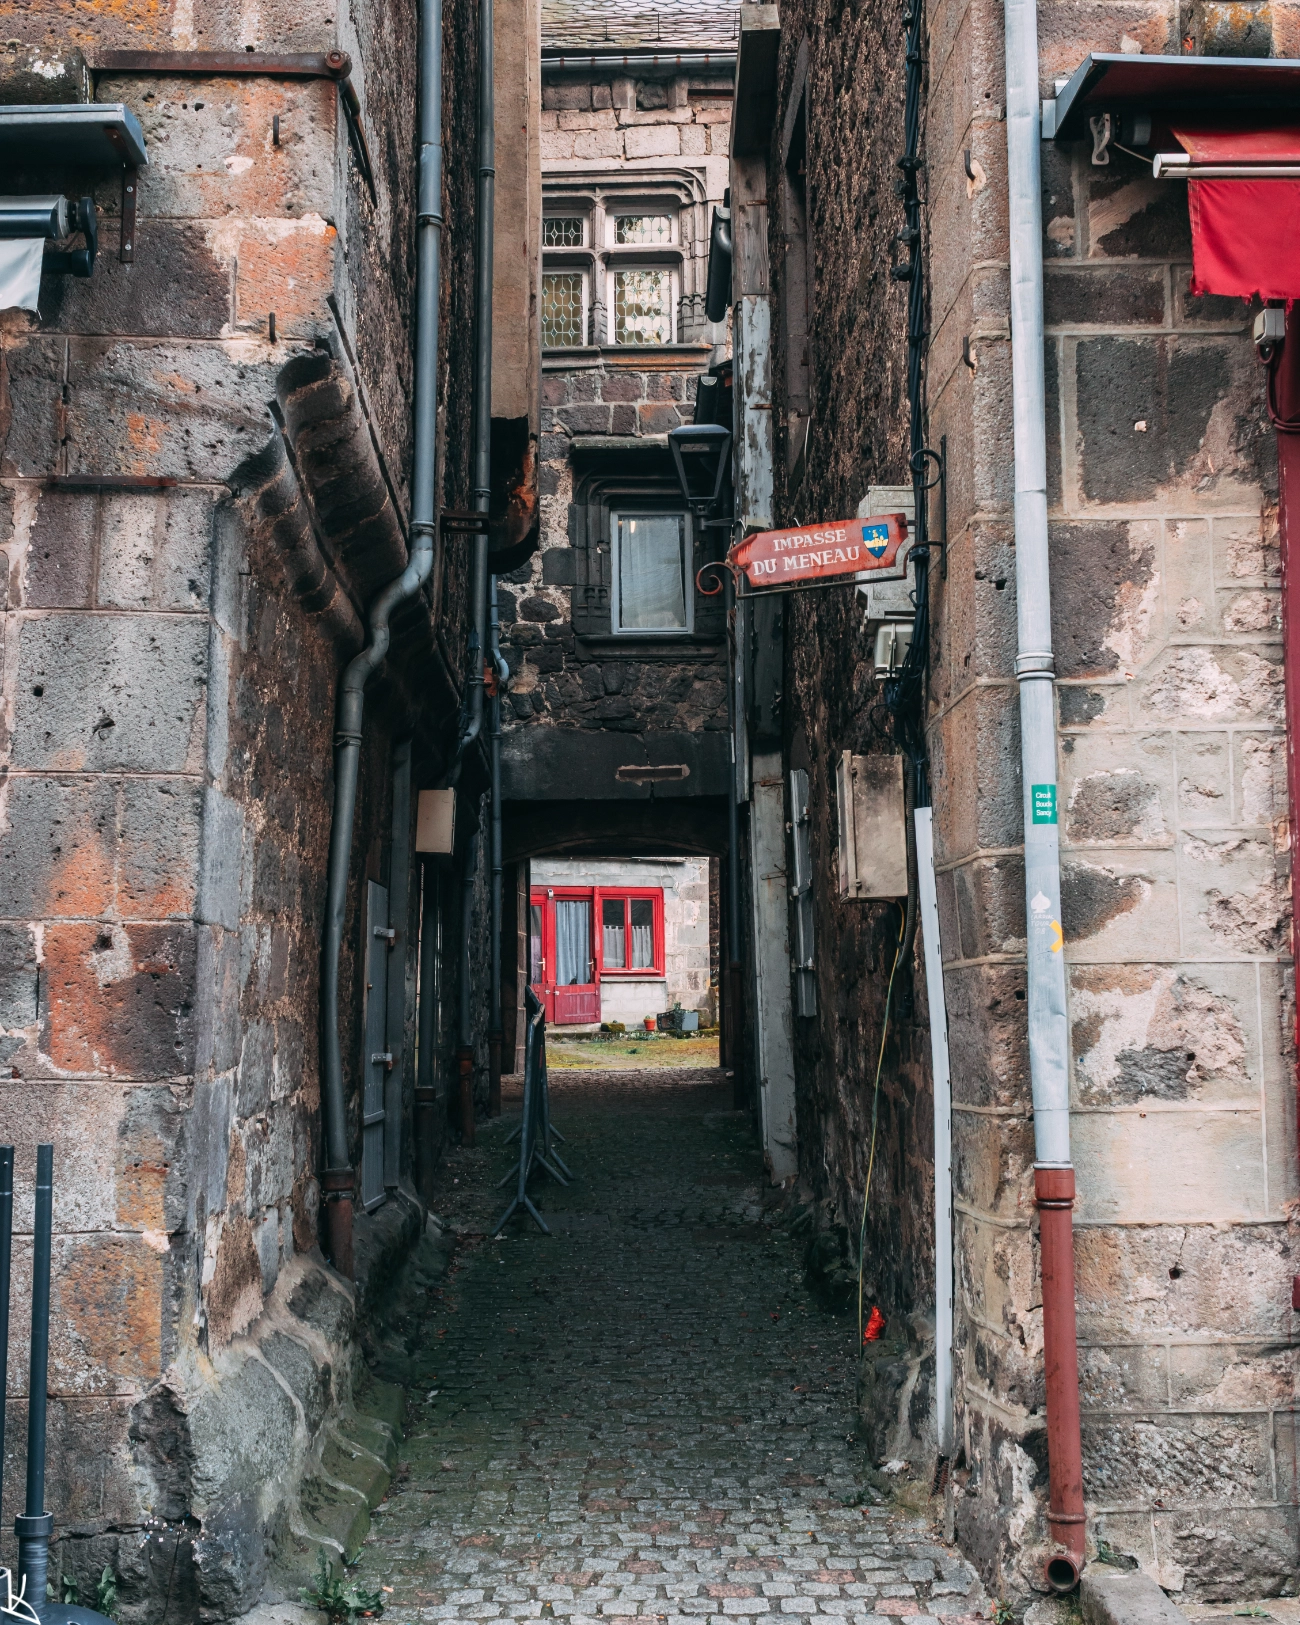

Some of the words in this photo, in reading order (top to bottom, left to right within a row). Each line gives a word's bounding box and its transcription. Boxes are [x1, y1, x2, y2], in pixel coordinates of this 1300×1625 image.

[773, 529, 847, 552] IMPASSE
[752, 558, 777, 576] DU
[783, 546, 860, 571] MENEAU
